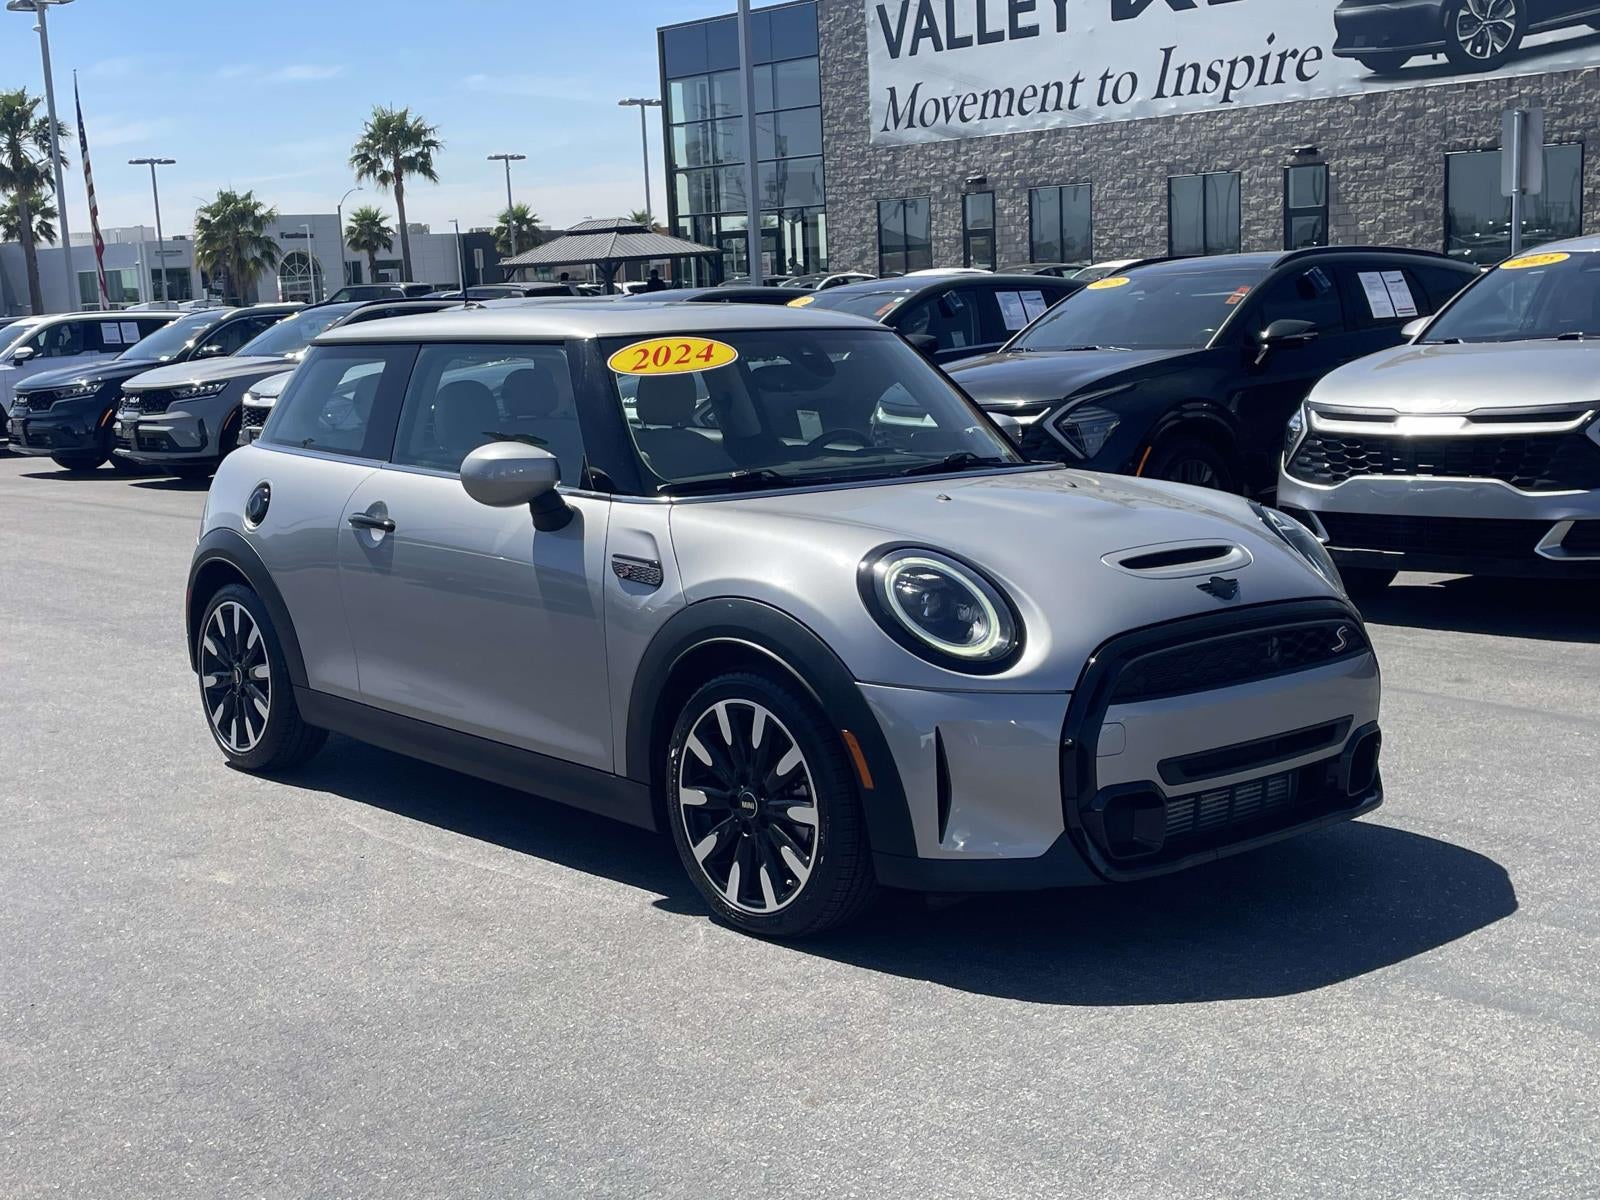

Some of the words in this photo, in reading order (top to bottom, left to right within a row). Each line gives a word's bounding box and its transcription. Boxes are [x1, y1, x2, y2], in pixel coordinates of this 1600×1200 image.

[876, 0, 1068, 59] VALLEY
[880, 71, 1085, 132] Movement
[1096, 66, 1138, 107] to
[1151, 32, 1323, 104] Inspire
[631, 343, 714, 371] 2024
[1331, 625, 1349, 653] S
